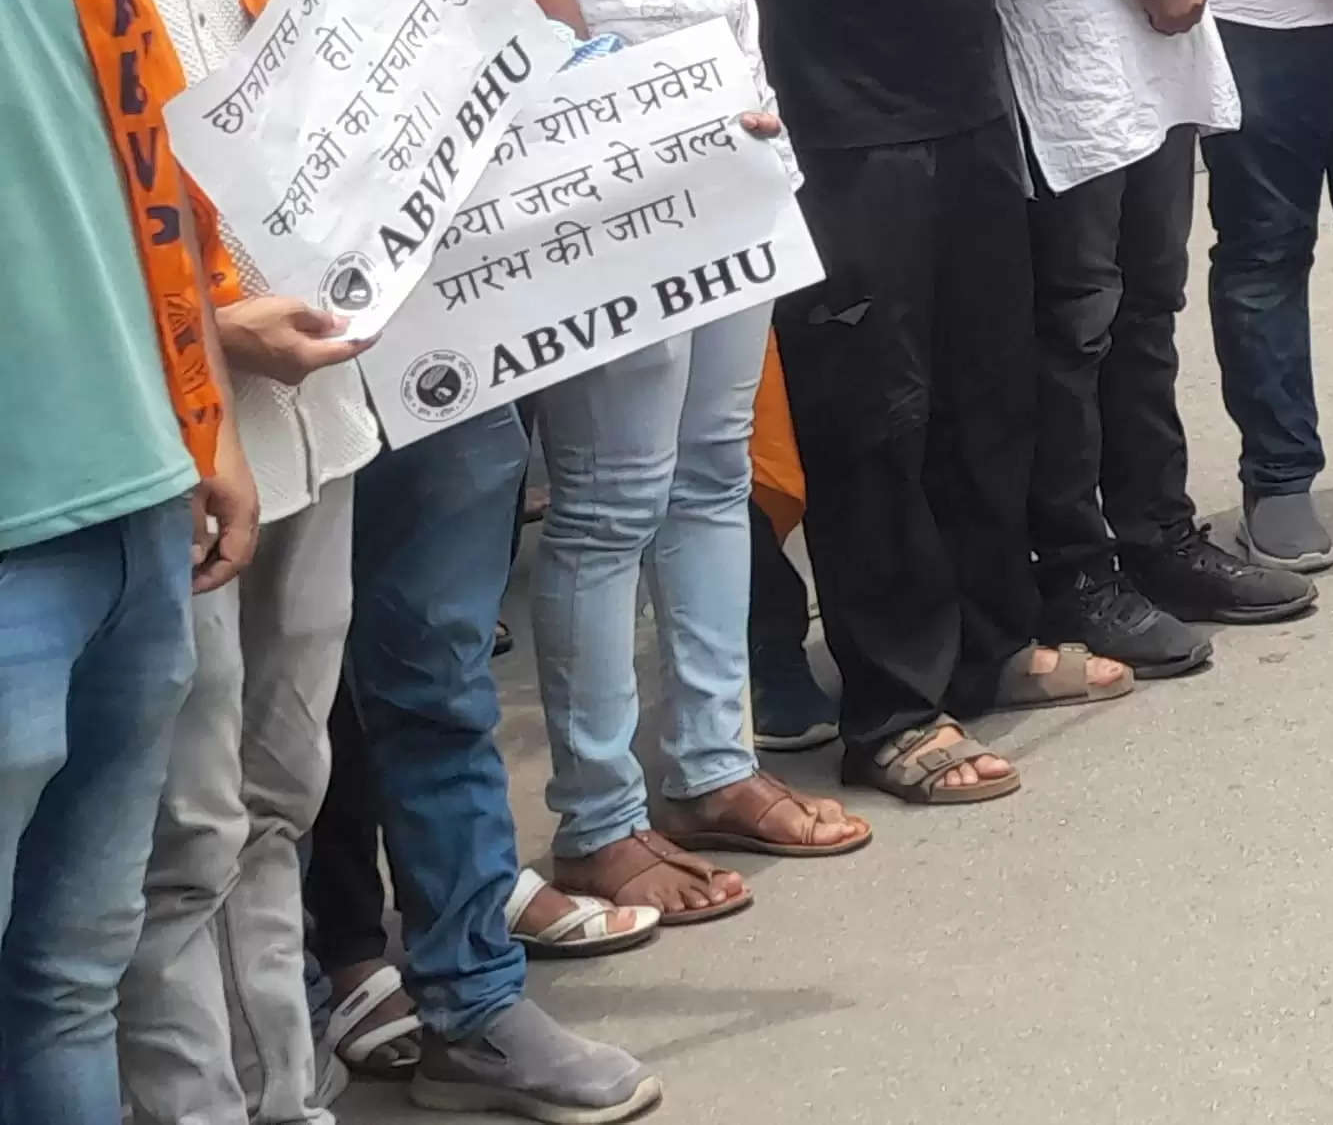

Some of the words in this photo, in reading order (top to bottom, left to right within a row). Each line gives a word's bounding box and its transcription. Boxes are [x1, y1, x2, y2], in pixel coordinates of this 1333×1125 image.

[202, 11, 300, 134] छात्रावास
[535, 96, 622, 145] शोध
[628, 56, 723, 116] प्रवेश
[262, 125, 346, 238] कक्षाओं
[336, 91, 380, 138] का
[377, 136, 467, 273] ABVP
[454, 35, 533, 149] BHU
[511, 165, 602, 219] जल्द
[603, 141, 644, 184] से
[650, 115, 738, 166] जल्द
[433, 249, 533, 311] प्रारंभ
[541, 220, 595, 266] की
[489, 295, 638, 388] ABVP
[651, 241, 778, 321] BHU
